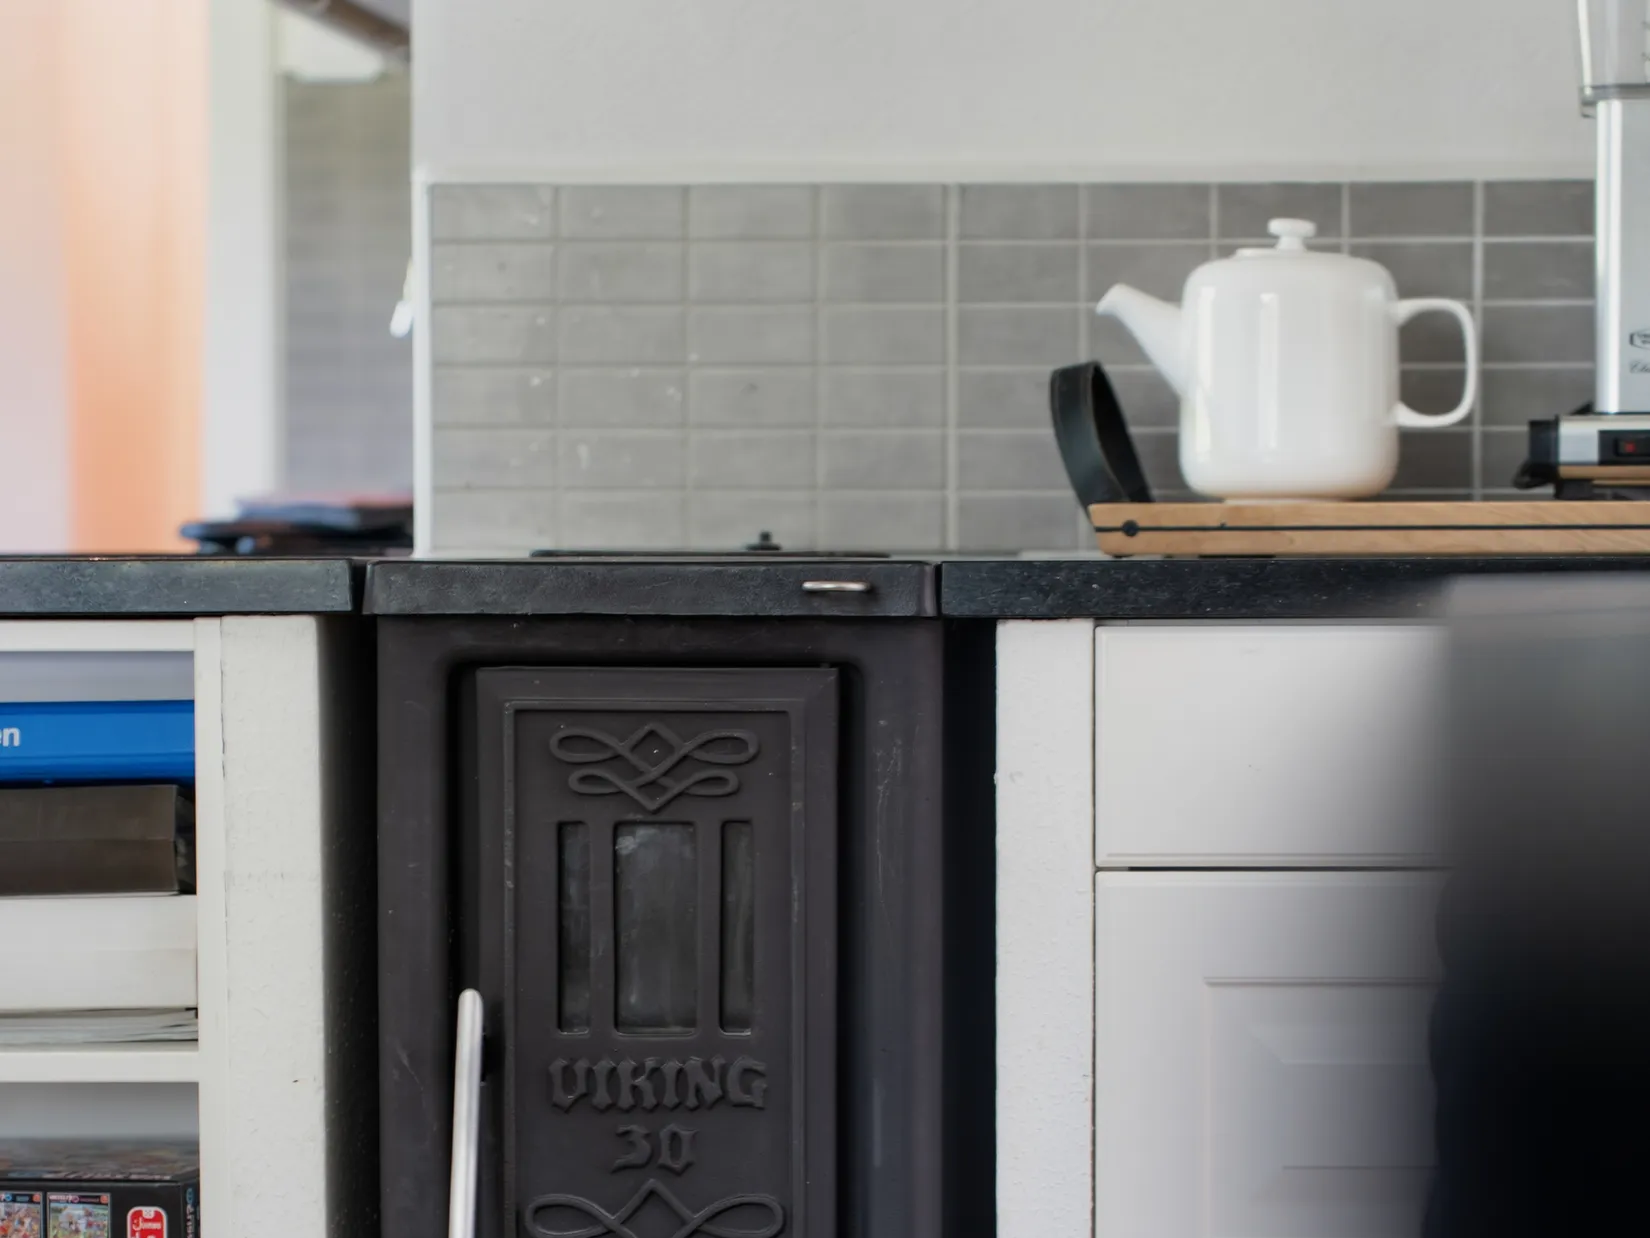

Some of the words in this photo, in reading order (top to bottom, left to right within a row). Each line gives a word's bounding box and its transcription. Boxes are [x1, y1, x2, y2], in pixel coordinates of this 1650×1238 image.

[0, 727, 21, 747] n
[549, 1056, 768, 1113] VIKING
[610, 1123, 700, 1176] 30
